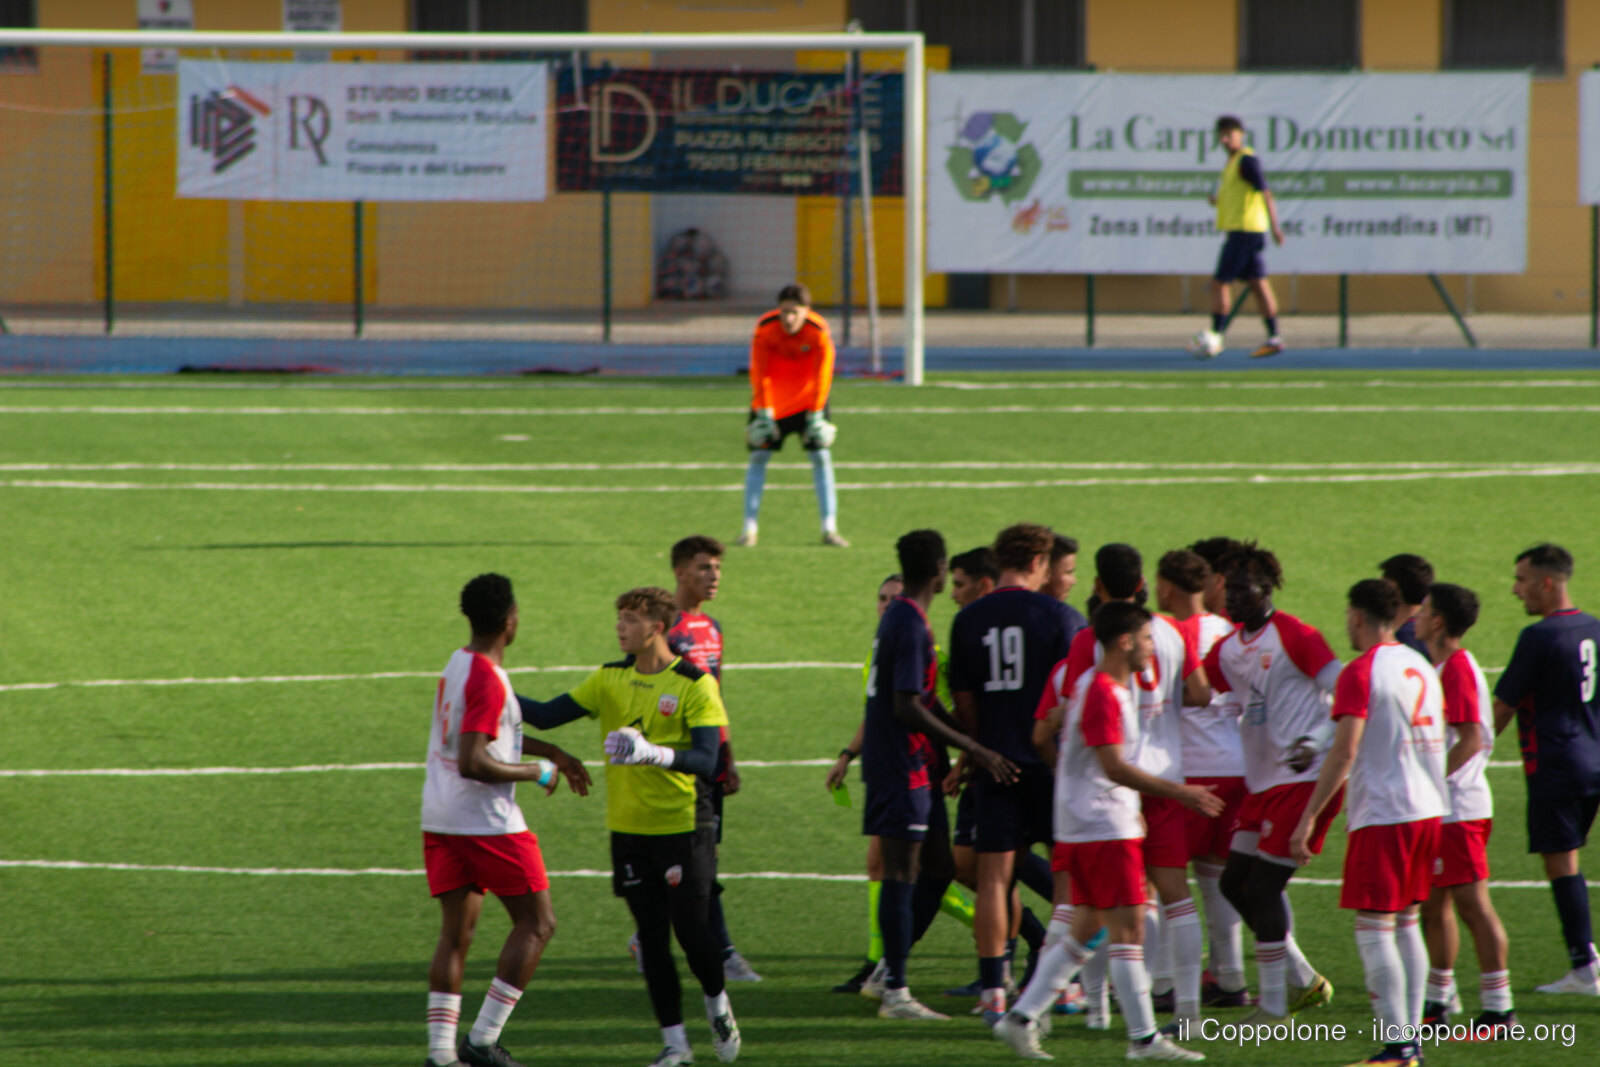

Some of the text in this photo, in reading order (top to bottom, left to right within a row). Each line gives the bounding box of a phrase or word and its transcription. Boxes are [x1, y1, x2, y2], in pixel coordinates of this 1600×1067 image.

[671, 77, 883, 115] IL DUCALE
[742, 153, 868, 174] FERRANDIN
[1068, 113, 1515, 164] La Carpa Domenico Srl
[1089, 216, 1139, 236] Zona
[1323, 215, 1439, 236] Ferrandina
[1445, 215, 1493, 239] (MT)
[981, 626, 1025, 692] 19
[1579, 638, 1598, 703] 3
[1403, 667, 1434, 727] 2
